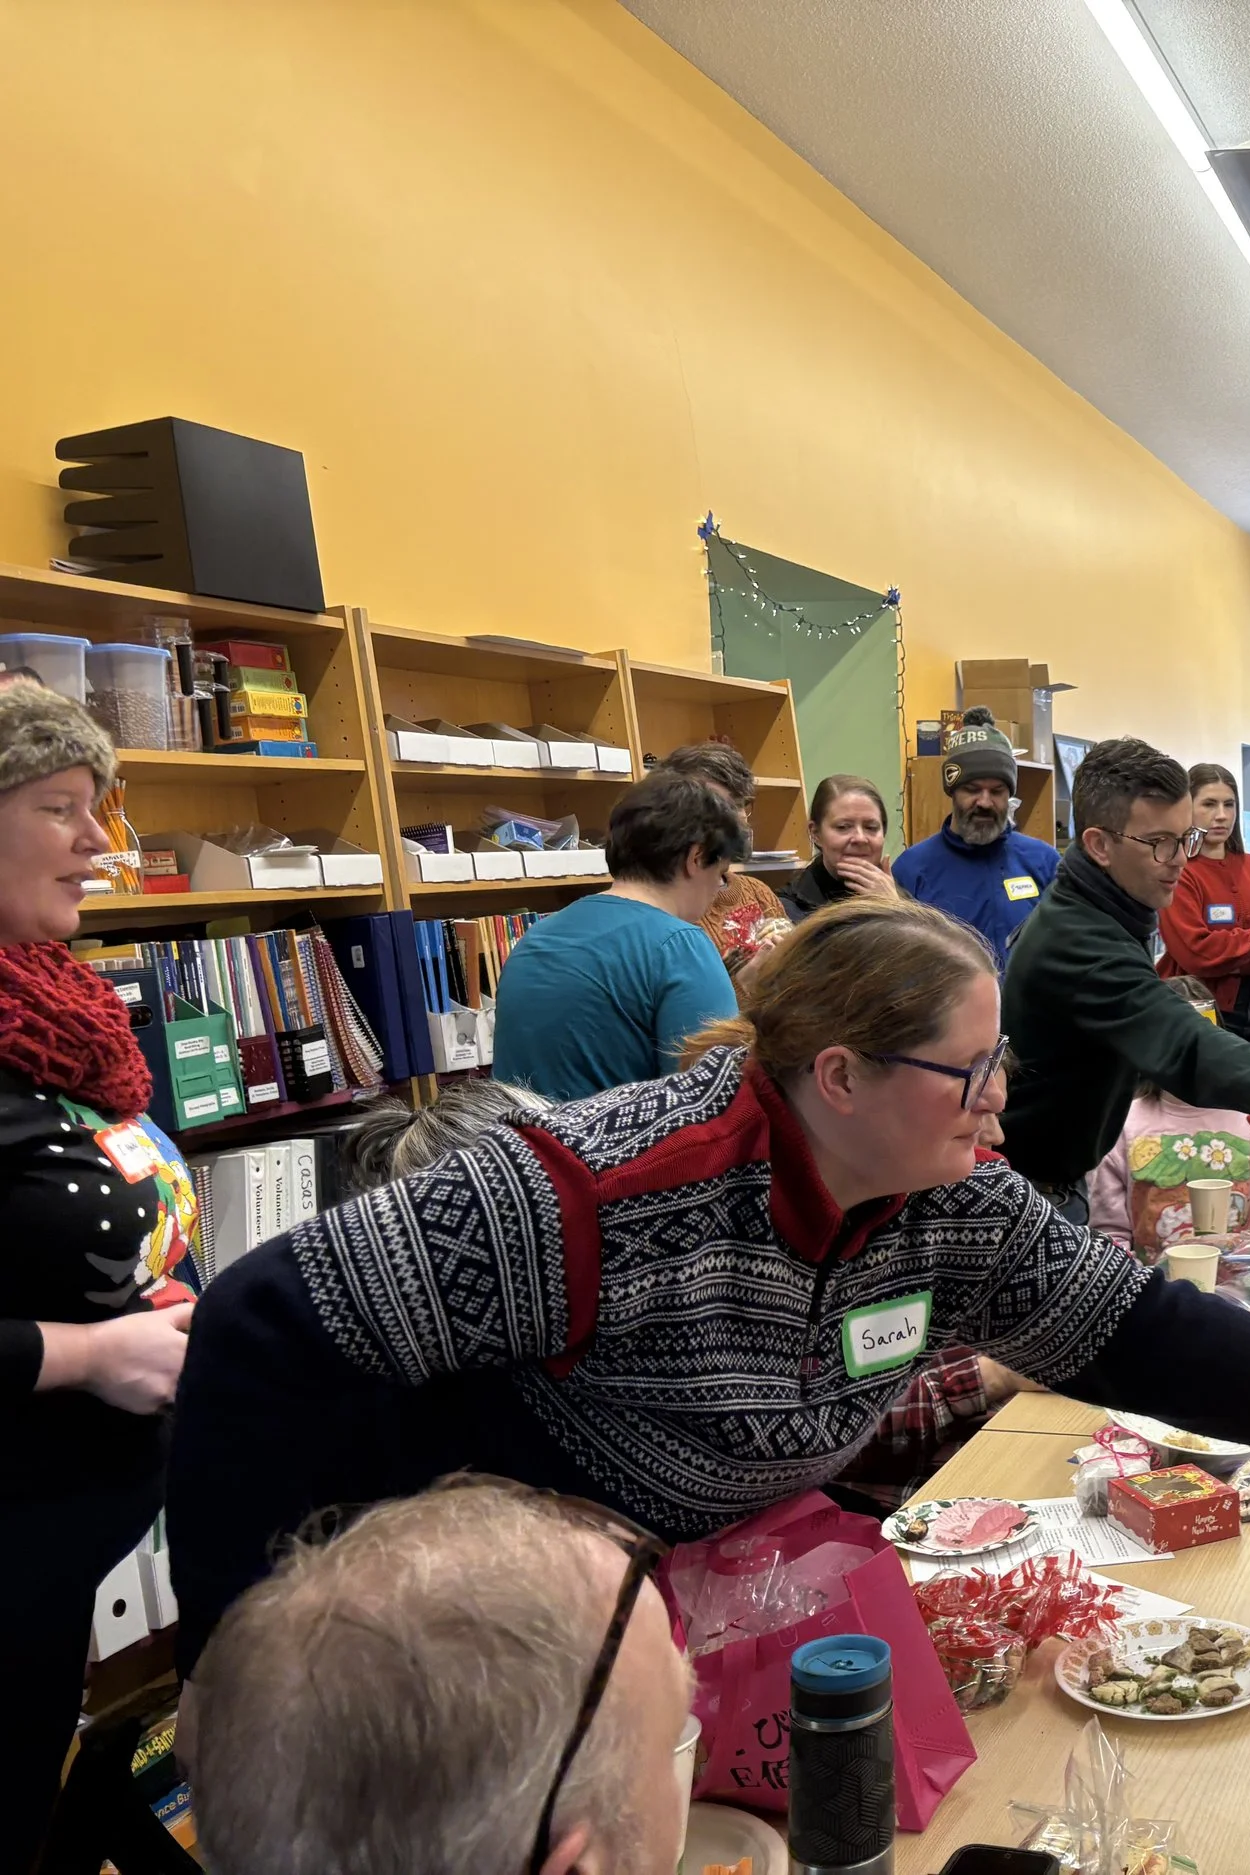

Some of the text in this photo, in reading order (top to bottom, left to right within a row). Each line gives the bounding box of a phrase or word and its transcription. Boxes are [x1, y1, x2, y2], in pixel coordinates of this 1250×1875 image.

[297, 1154, 314, 1210] Casas
[862, 1317, 917, 1350] Sarah
[1191, 1525, 1204, 1535] New
[1195, 1514, 1218, 1525] Happy
